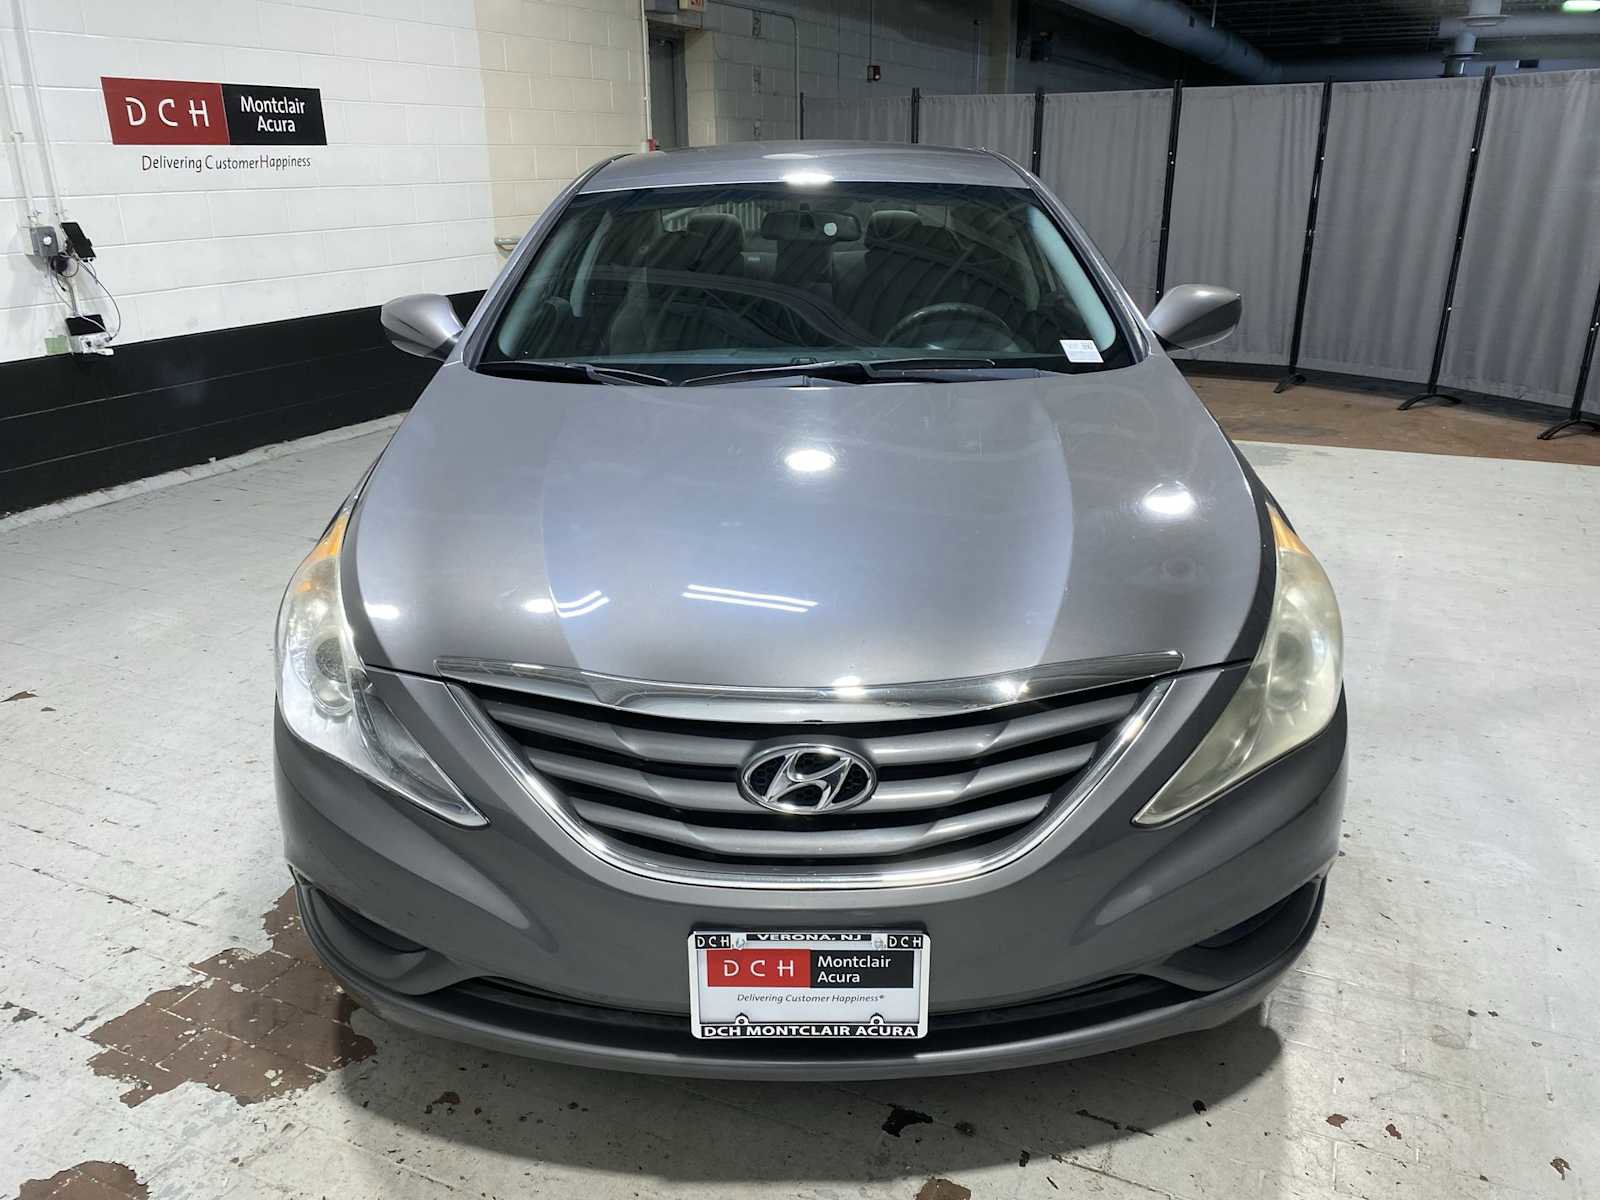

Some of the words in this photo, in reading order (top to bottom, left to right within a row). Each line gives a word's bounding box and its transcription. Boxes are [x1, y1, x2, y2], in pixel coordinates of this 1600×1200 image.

[240, 96, 305, 114] Montclair
[257, 115, 296, 133] Acura
[142, 155, 202, 173] Delivering
[697, 936, 730, 948] DCH
[889, 936, 922, 948] DCH
[817, 955, 892, 968] Montclair
[723, 960, 794, 977] DCH
[817, 971, 860, 983] Acura
[737, 994, 783, 1004] Delivering
[785, 994, 830, 1003] Customer
[704, 1026, 741, 1037] DCH
[746, 1026, 853, 1036] MONTCLAIR
[856, 1025, 915, 1036] ACURA
